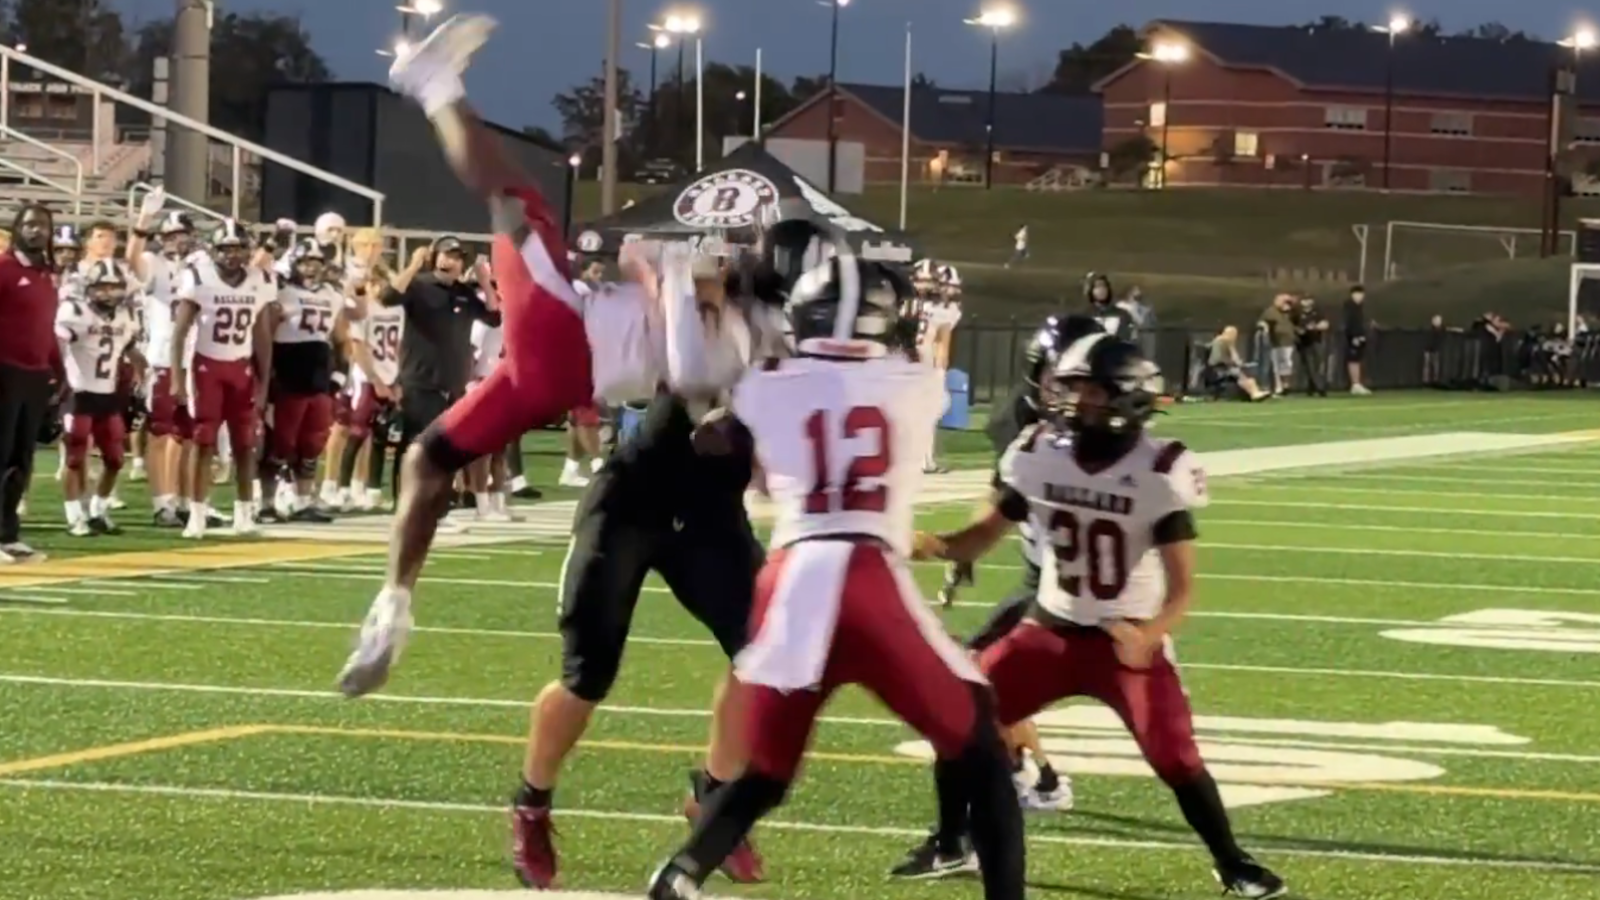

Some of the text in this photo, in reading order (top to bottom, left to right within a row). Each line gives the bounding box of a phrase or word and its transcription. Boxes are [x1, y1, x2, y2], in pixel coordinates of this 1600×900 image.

[713, 187, 740, 212] B
[212, 307, 252, 345] 29
[372, 325, 400, 361] 39
[94, 336, 114, 379] 2
[805, 405, 889, 513] 12
[1051, 510, 1127, 600] 20
